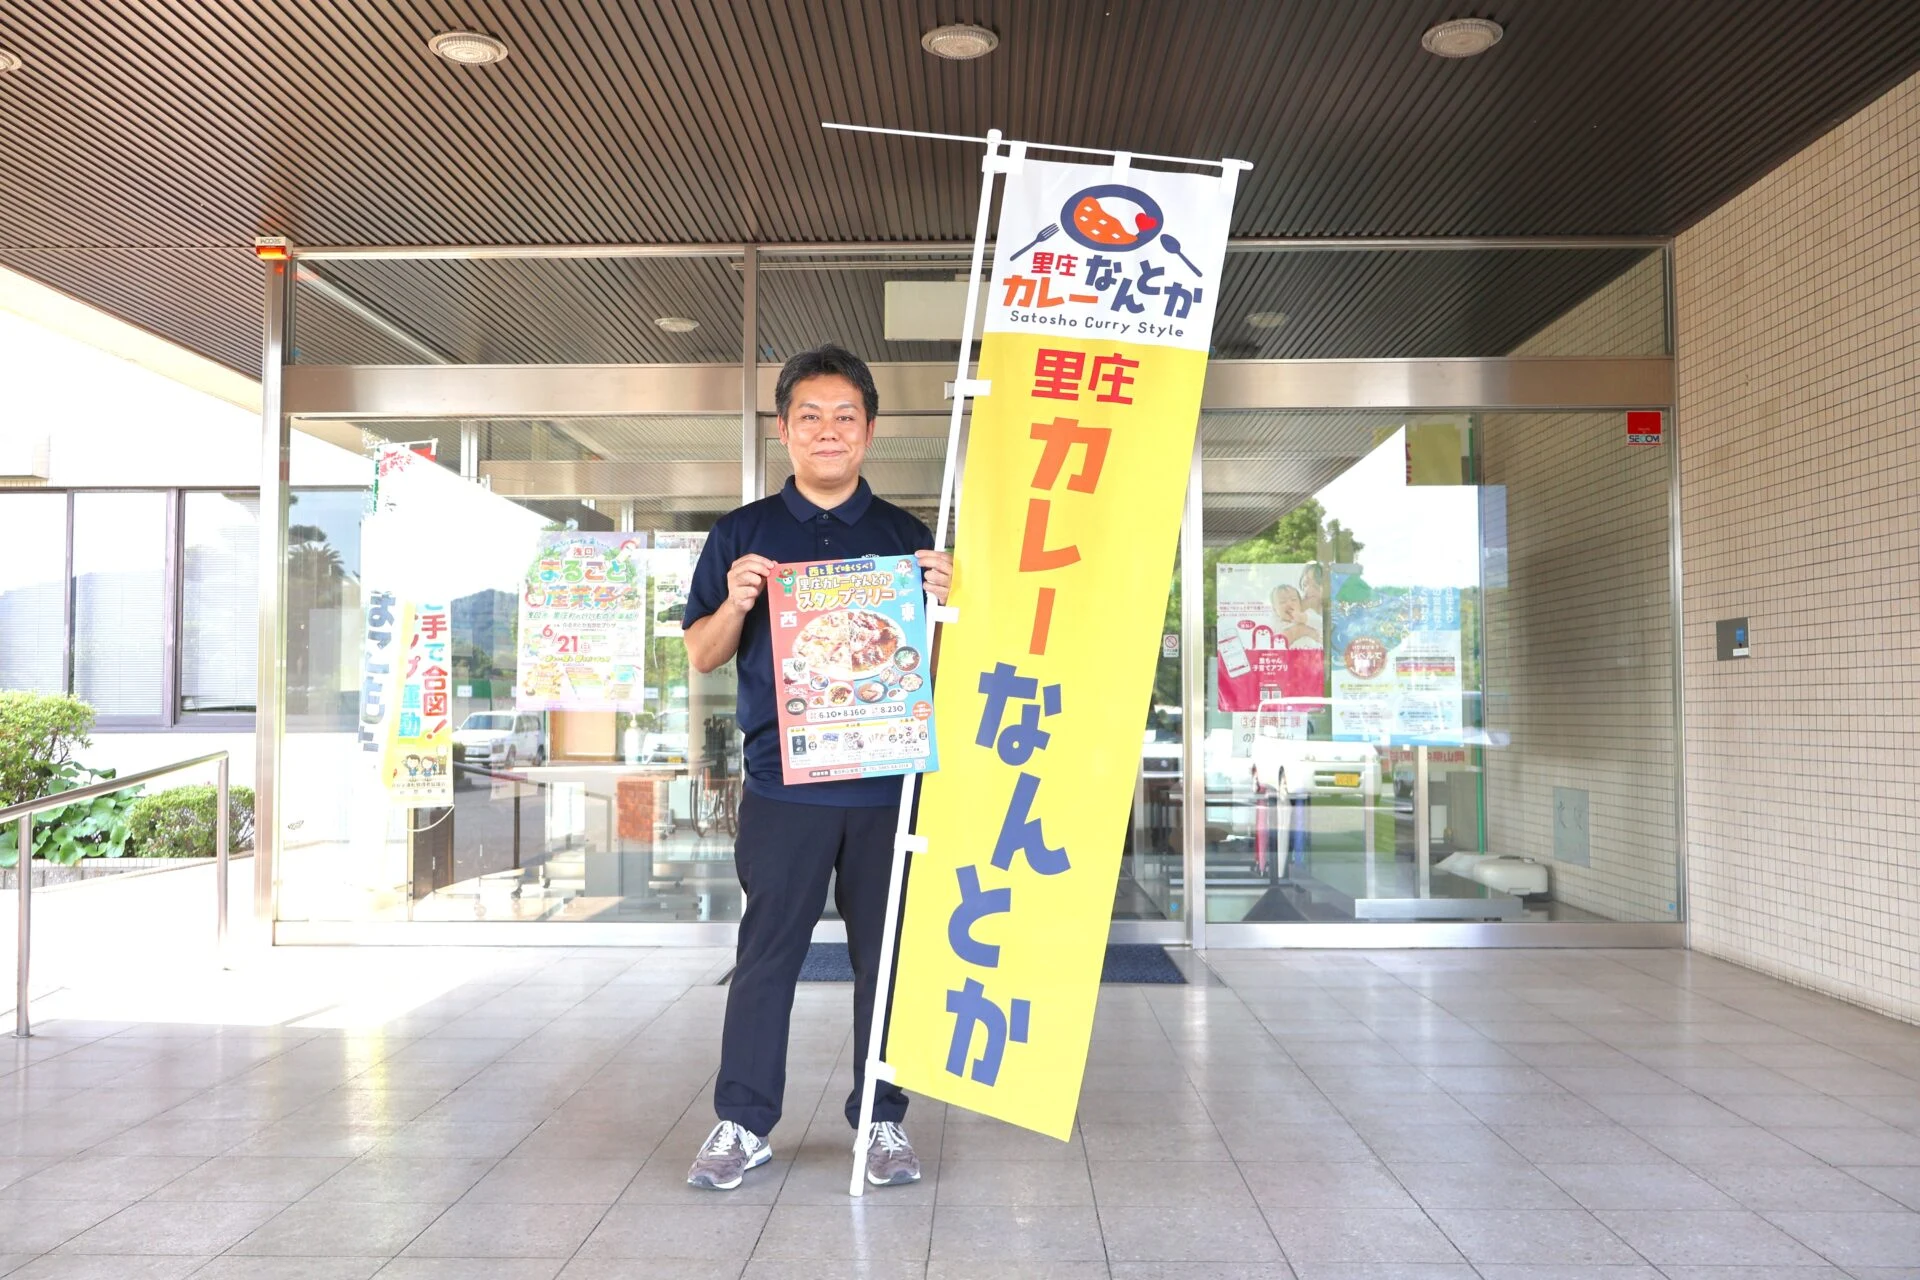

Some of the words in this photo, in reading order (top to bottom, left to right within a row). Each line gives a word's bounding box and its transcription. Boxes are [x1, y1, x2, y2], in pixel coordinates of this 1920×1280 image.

[1031, 251, 1078, 276] 里庄
[1003, 274, 1099, 308] カレー
[1085, 254, 1203, 319] なんとか
[1010, 310, 1078, 327] Satosho
[1085, 316, 1130, 334] Curry
[1137, 321, 1184, 338] Style
[1031, 348, 1140, 405] 里庄
[1628, 434, 1660, 443] SECOM
[799, 572, 890, 591] 里庄カレーなんとか
[799, 587, 894, 610] スタンプラリー
[779, 611, 798, 628] 西
[901, 603, 915, 622] 東
[1252, 664, 1288, 672] 子育てアプリ
